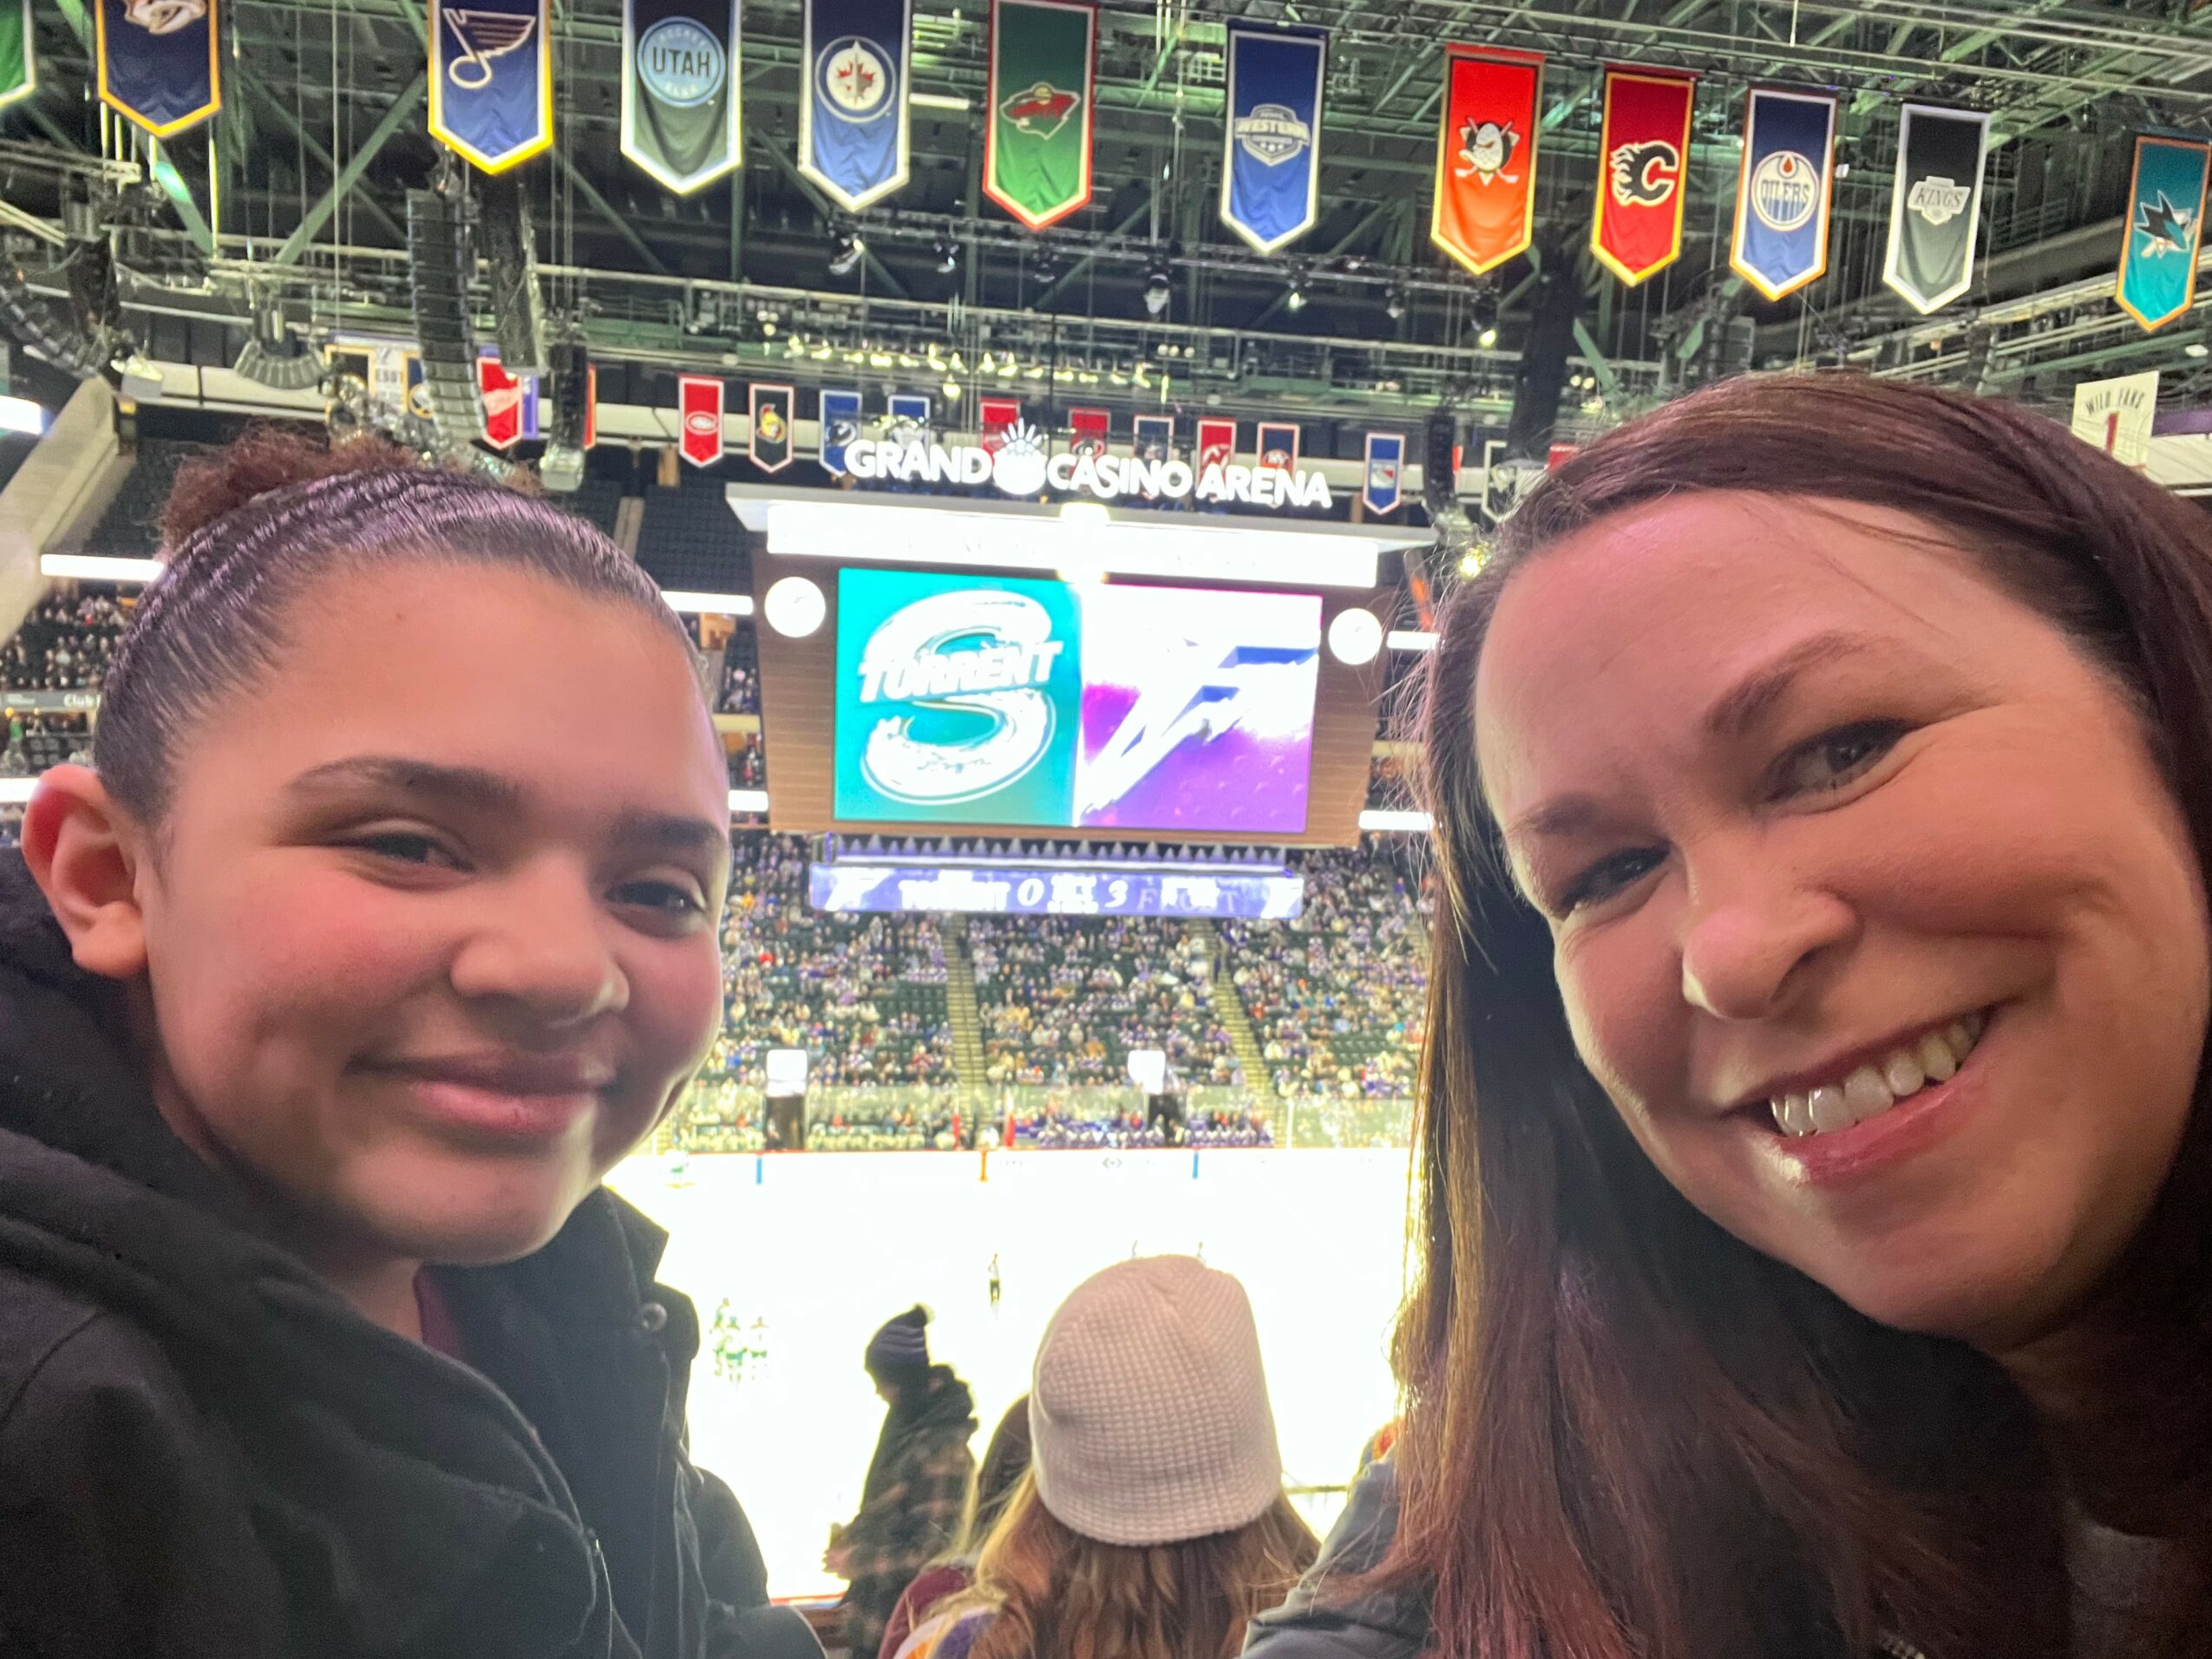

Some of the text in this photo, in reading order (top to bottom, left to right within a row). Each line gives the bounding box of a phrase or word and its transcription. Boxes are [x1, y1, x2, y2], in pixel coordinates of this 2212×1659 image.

[652, 46, 710, 77] UTAH
[1762, 179, 1810, 206] OILERS
[1914, 187, 1964, 208] KINGS
[2085, 387, 2146, 415] WILD FANS
[2105, 411, 2119, 456] 1
[844, 438, 992, 484] GRAND
[1047, 453, 1193, 499] CASINO
[1196, 461, 1332, 509] ARENA
[858, 640, 1064, 703] TORRENT
[1018, 878, 1045, 906] 0
